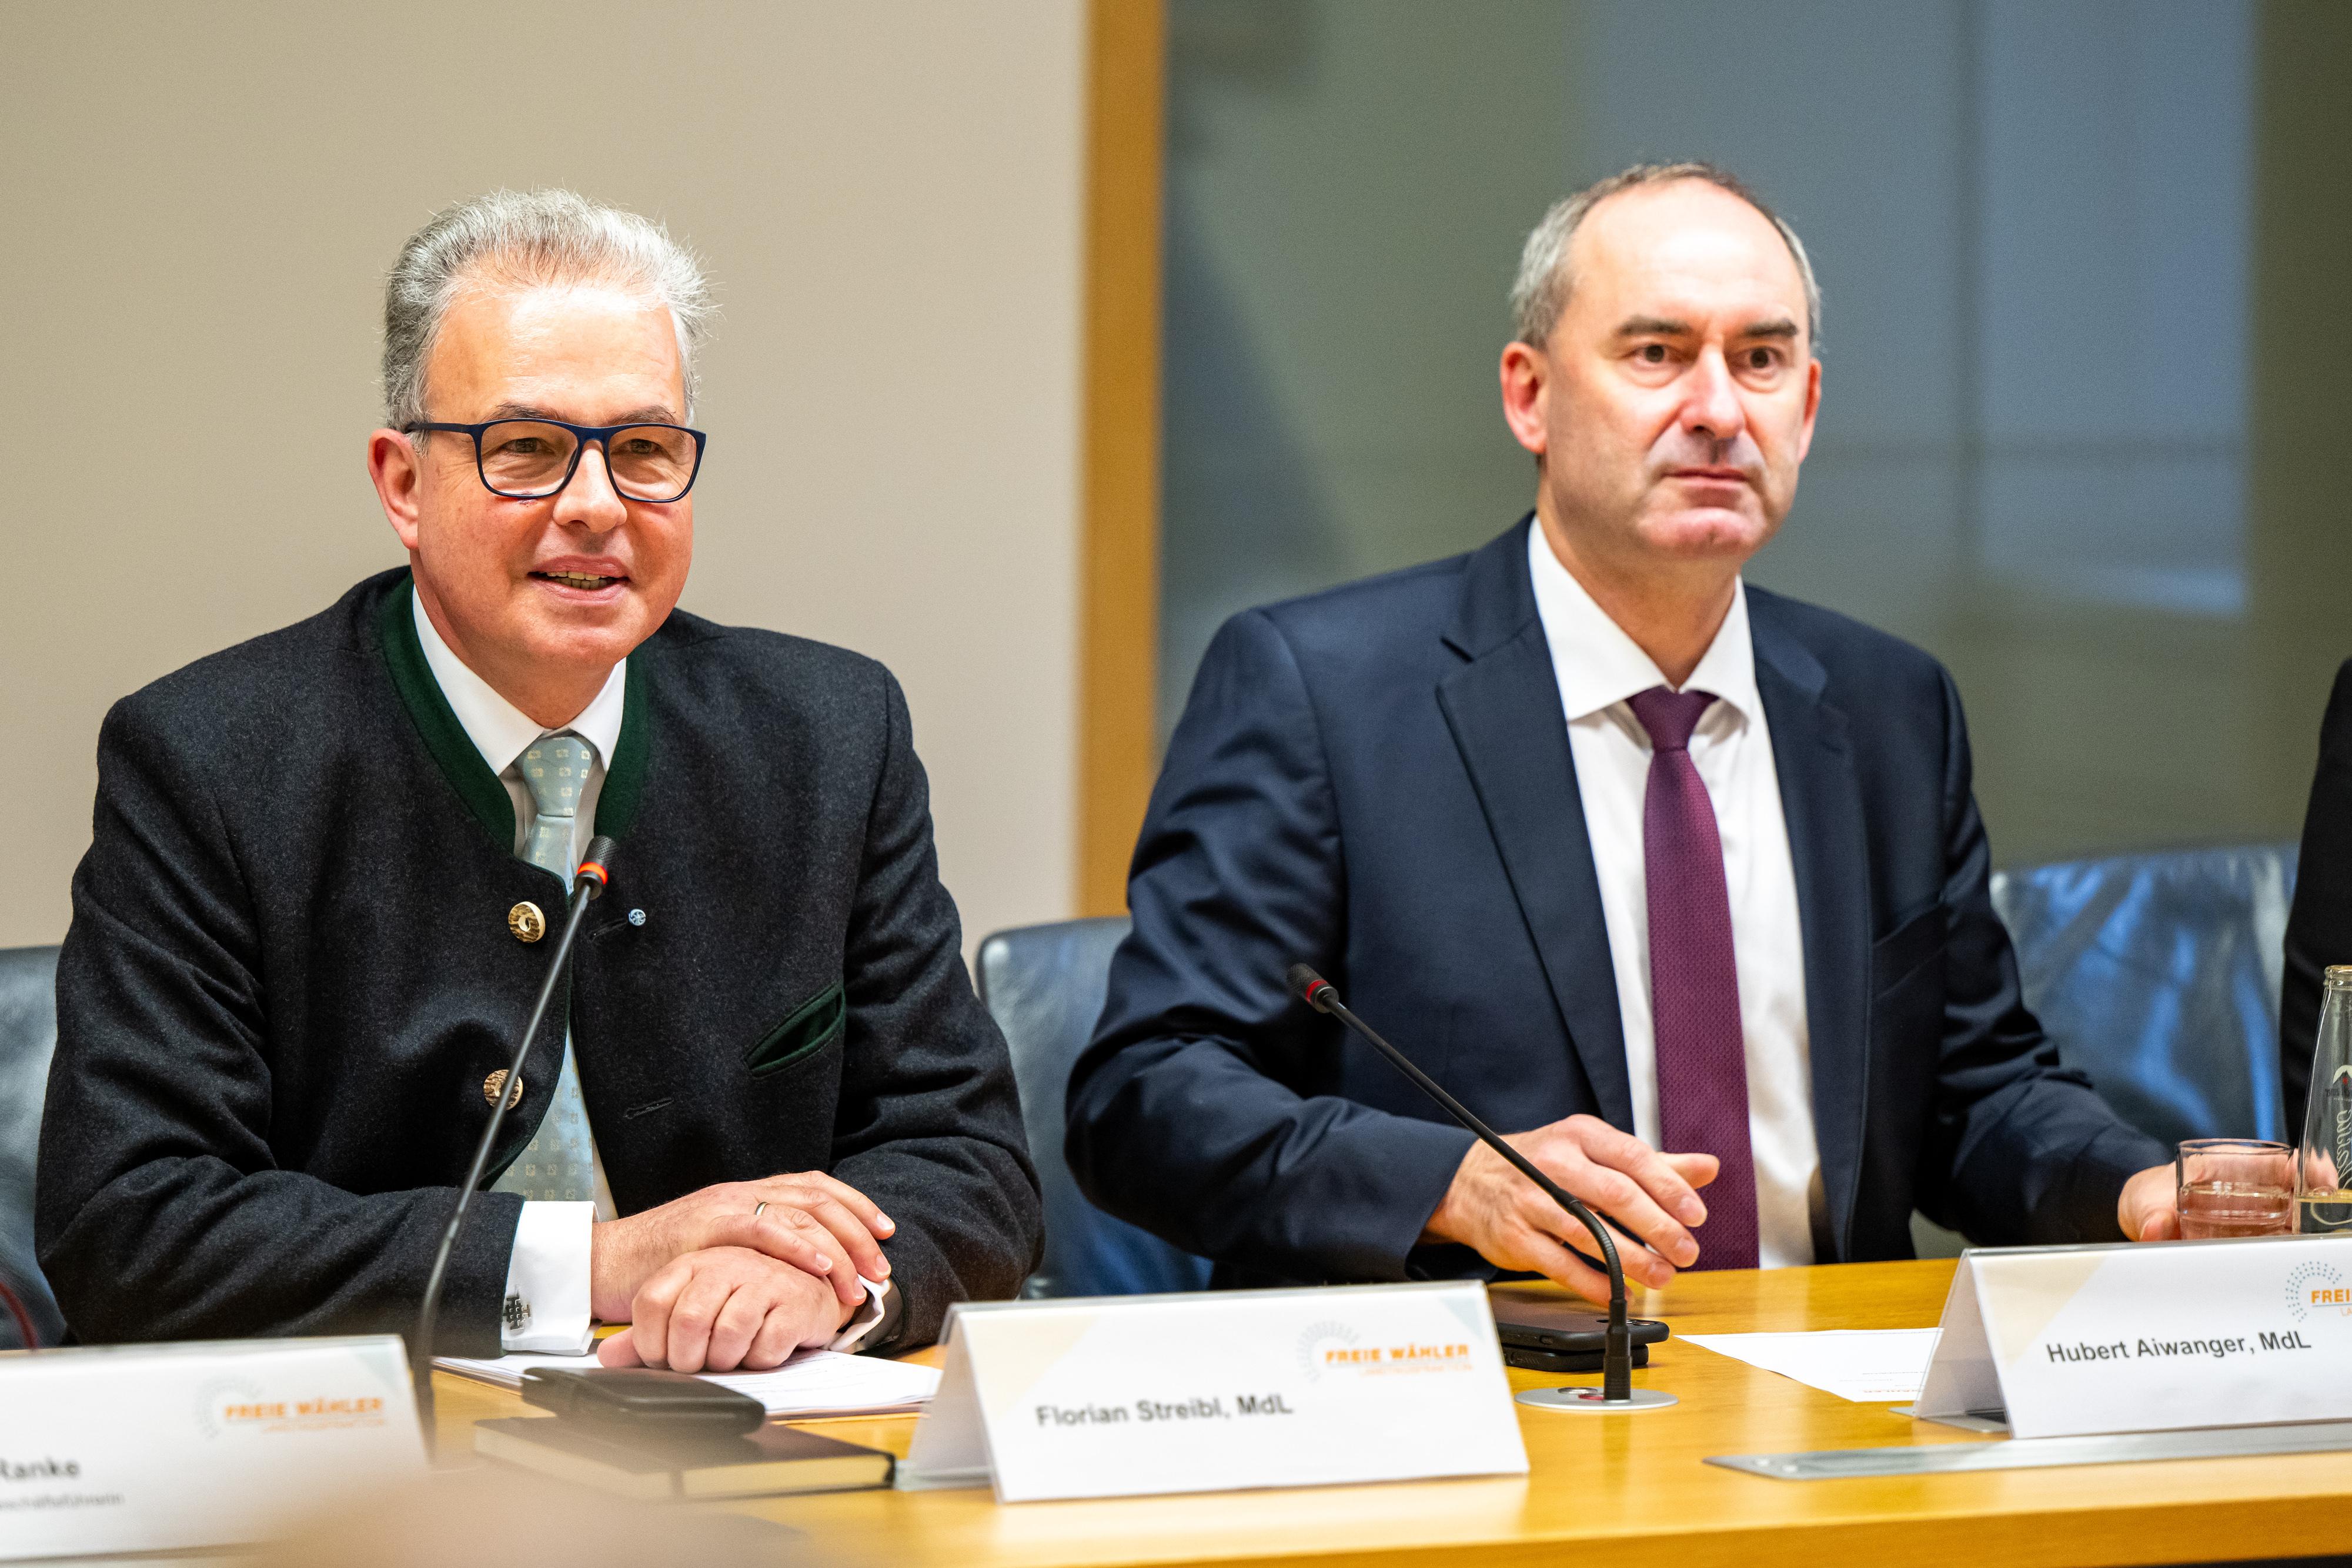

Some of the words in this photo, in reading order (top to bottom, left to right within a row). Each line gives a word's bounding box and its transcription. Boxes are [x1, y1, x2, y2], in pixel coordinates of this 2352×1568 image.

[2311, 1288, 2352, 1304] FREI
[1325, 1349, 1381, 1364] FREIE
[1389, 1342, 1469, 1359] WÄHLER
[2047, 1341, 2130, 1363] Hubert
[2136, 1338, 2254, 1358] Aiwanger,
[2258, 1330, 2311, 1351] MdL
[224, 1403, 286, 1419] FREIE
[1035, 1404, 1128, 1427] Florian
[1136, 1397, 1231, 1422] Streibl,
[1235, 1394, 1294, 1415] MdL
